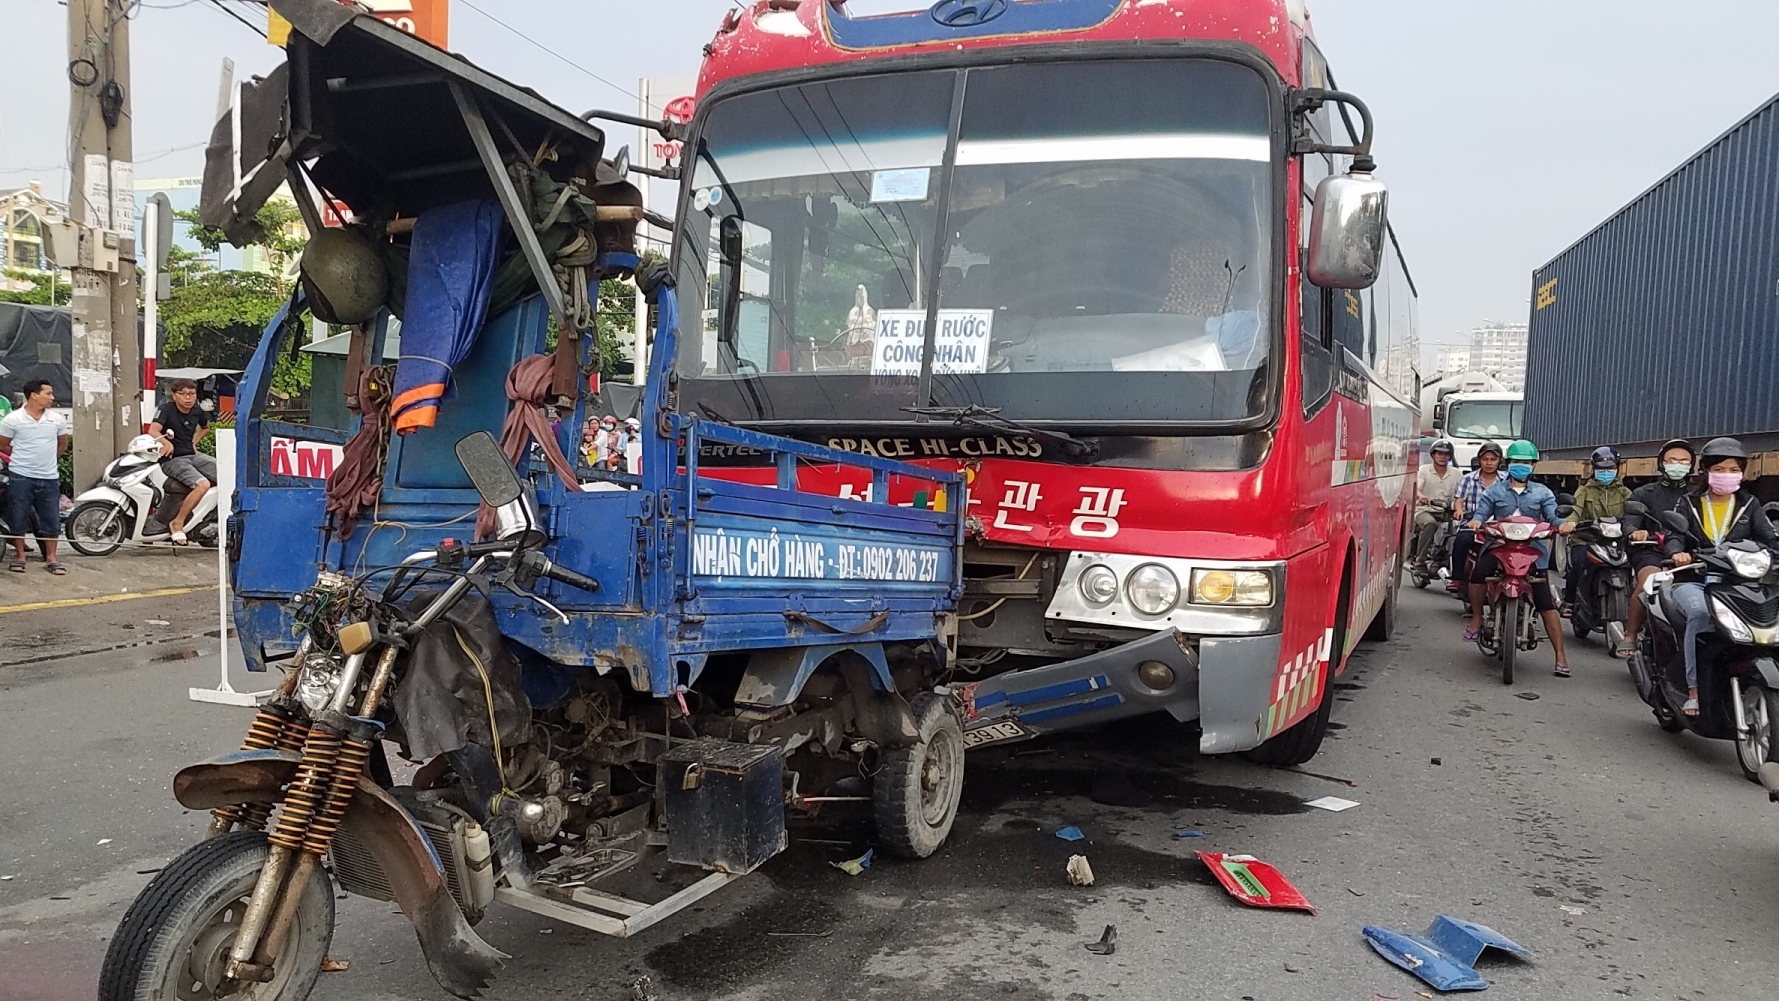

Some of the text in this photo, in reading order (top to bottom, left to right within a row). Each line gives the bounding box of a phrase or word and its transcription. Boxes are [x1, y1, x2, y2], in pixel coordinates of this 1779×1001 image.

[880, 320, 900, 337] XE
[905, 320, 926, 337] ĐU
[828, 436, 1043, 457] SPACE HI-CLASS
[693, 527, 742, 583] NHẬN
[785, 534, 824, 579] HÀNG
[896, 548, 916, 581] 206
[919, 551, 938, 582] 237
